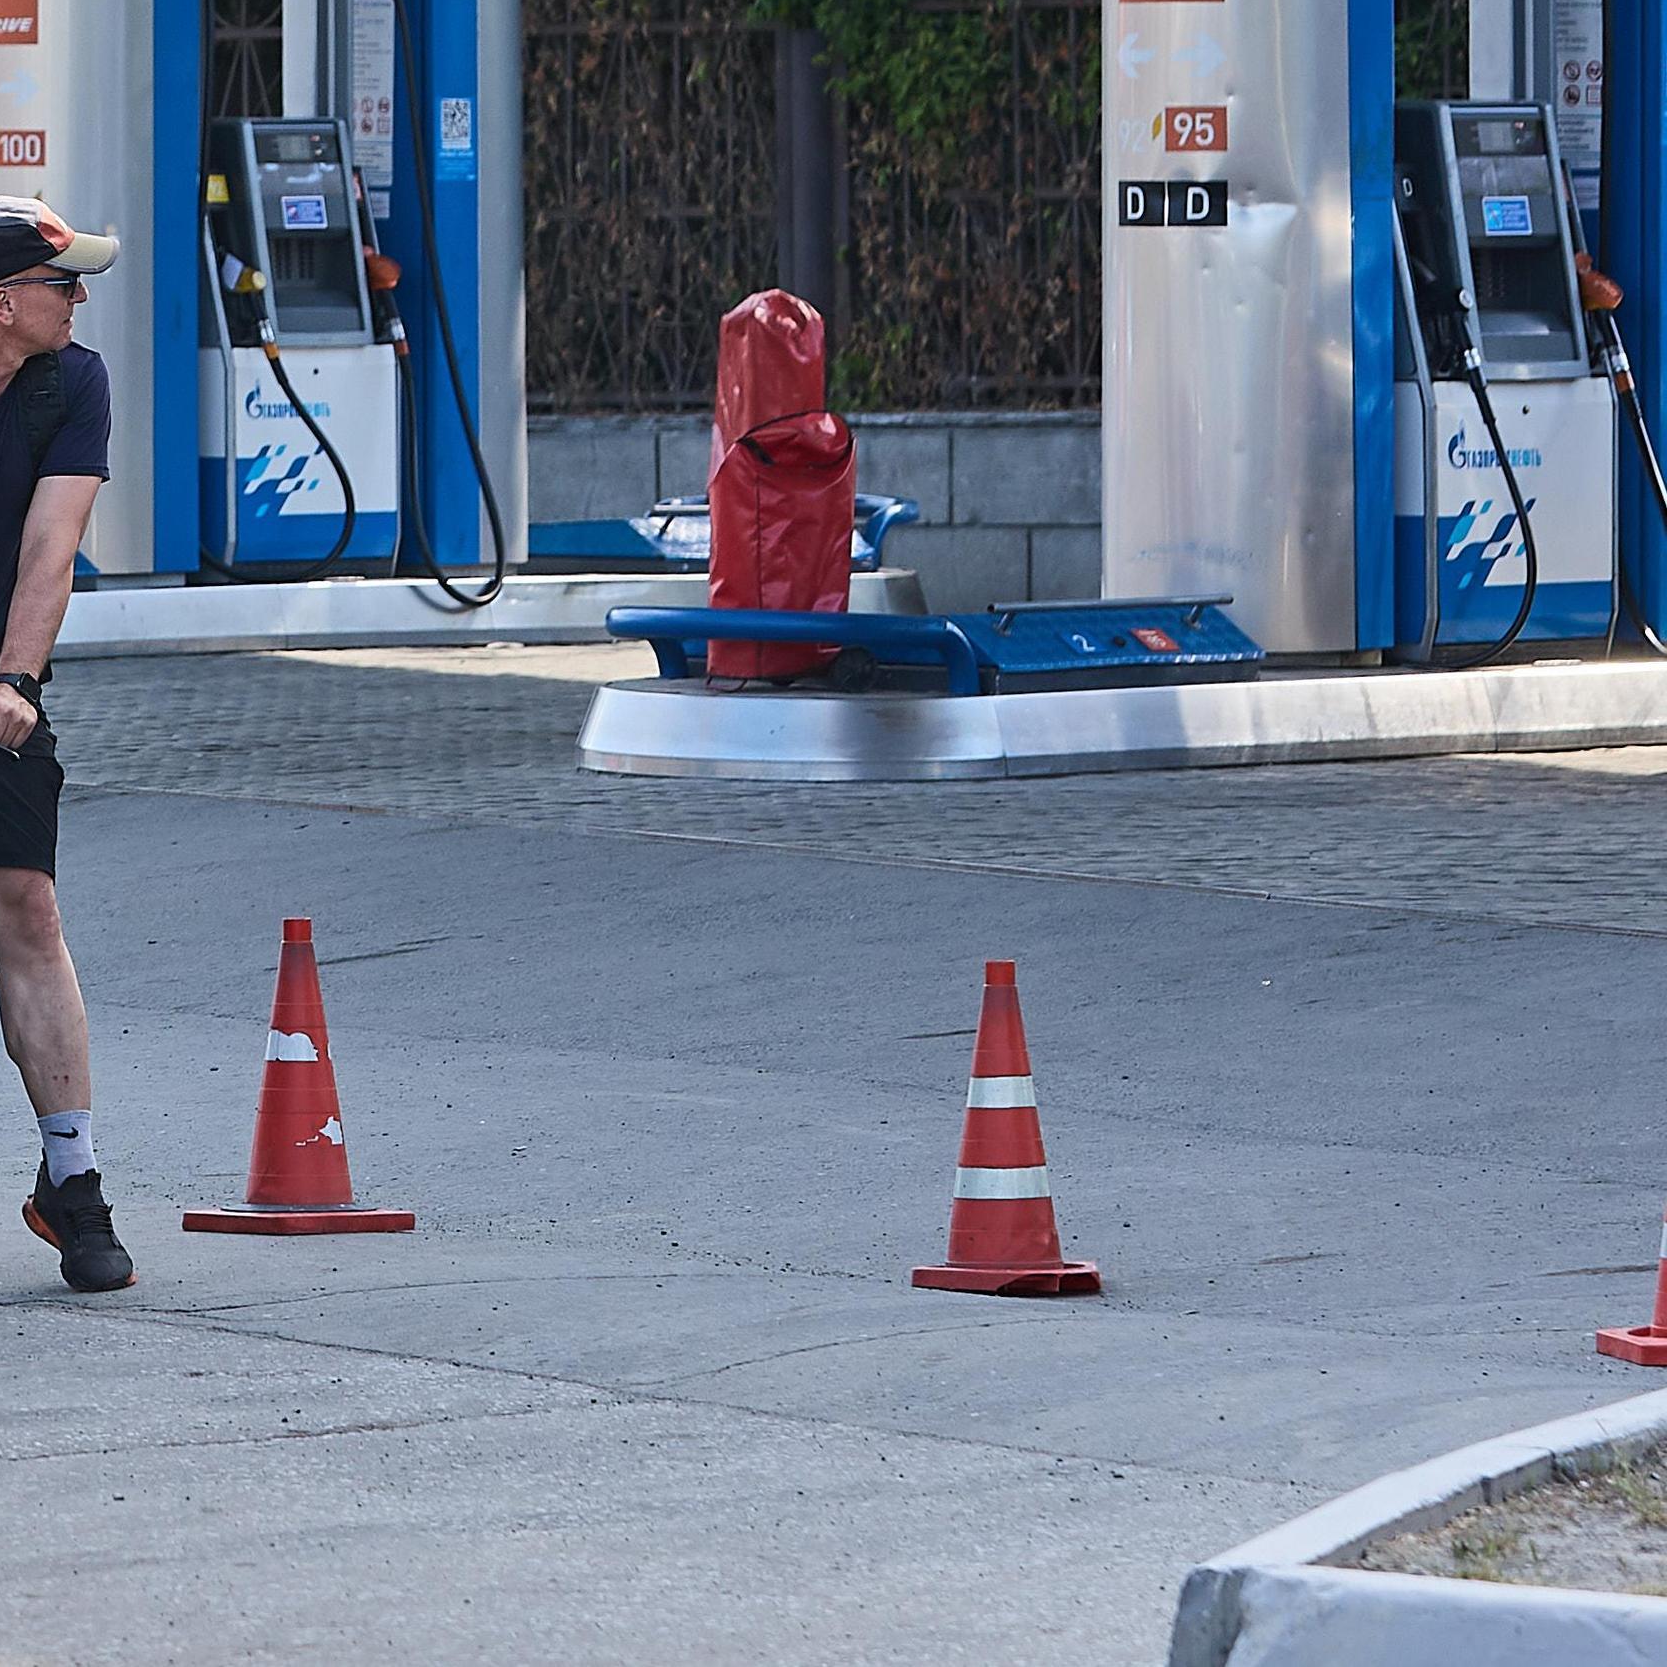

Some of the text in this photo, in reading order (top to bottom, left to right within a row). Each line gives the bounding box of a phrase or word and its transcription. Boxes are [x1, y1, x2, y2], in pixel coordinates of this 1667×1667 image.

[1173, 111, 1215, 148] 95
[1126, 185, 1210, 221] D D
